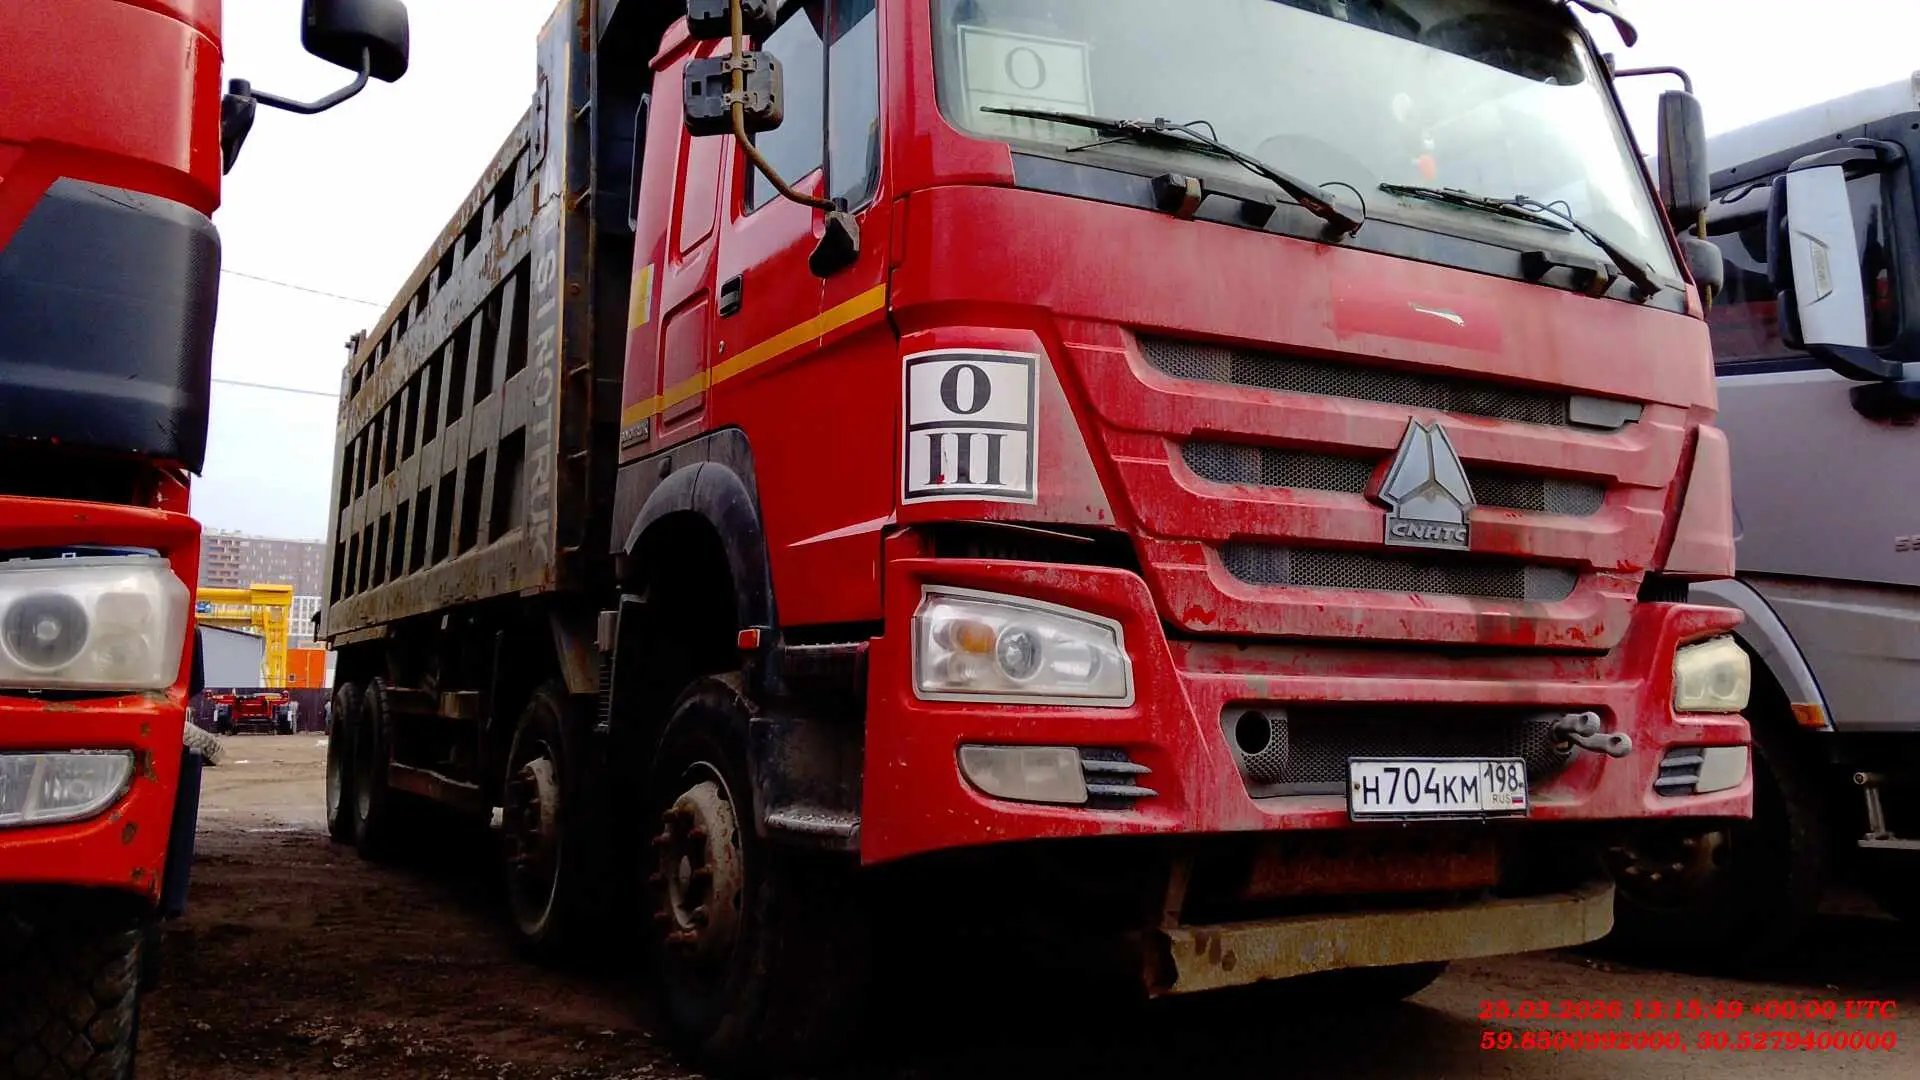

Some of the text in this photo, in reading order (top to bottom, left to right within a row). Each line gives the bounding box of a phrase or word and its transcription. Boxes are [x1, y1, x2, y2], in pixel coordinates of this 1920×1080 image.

[530, 248, 556, 565] SINOTRUK
[1391, 523, 1467, 541] CNHTC
[1362, 763, 1518, 804] Н704КМ 198
[1492, 794, 1512, 805] RUS
